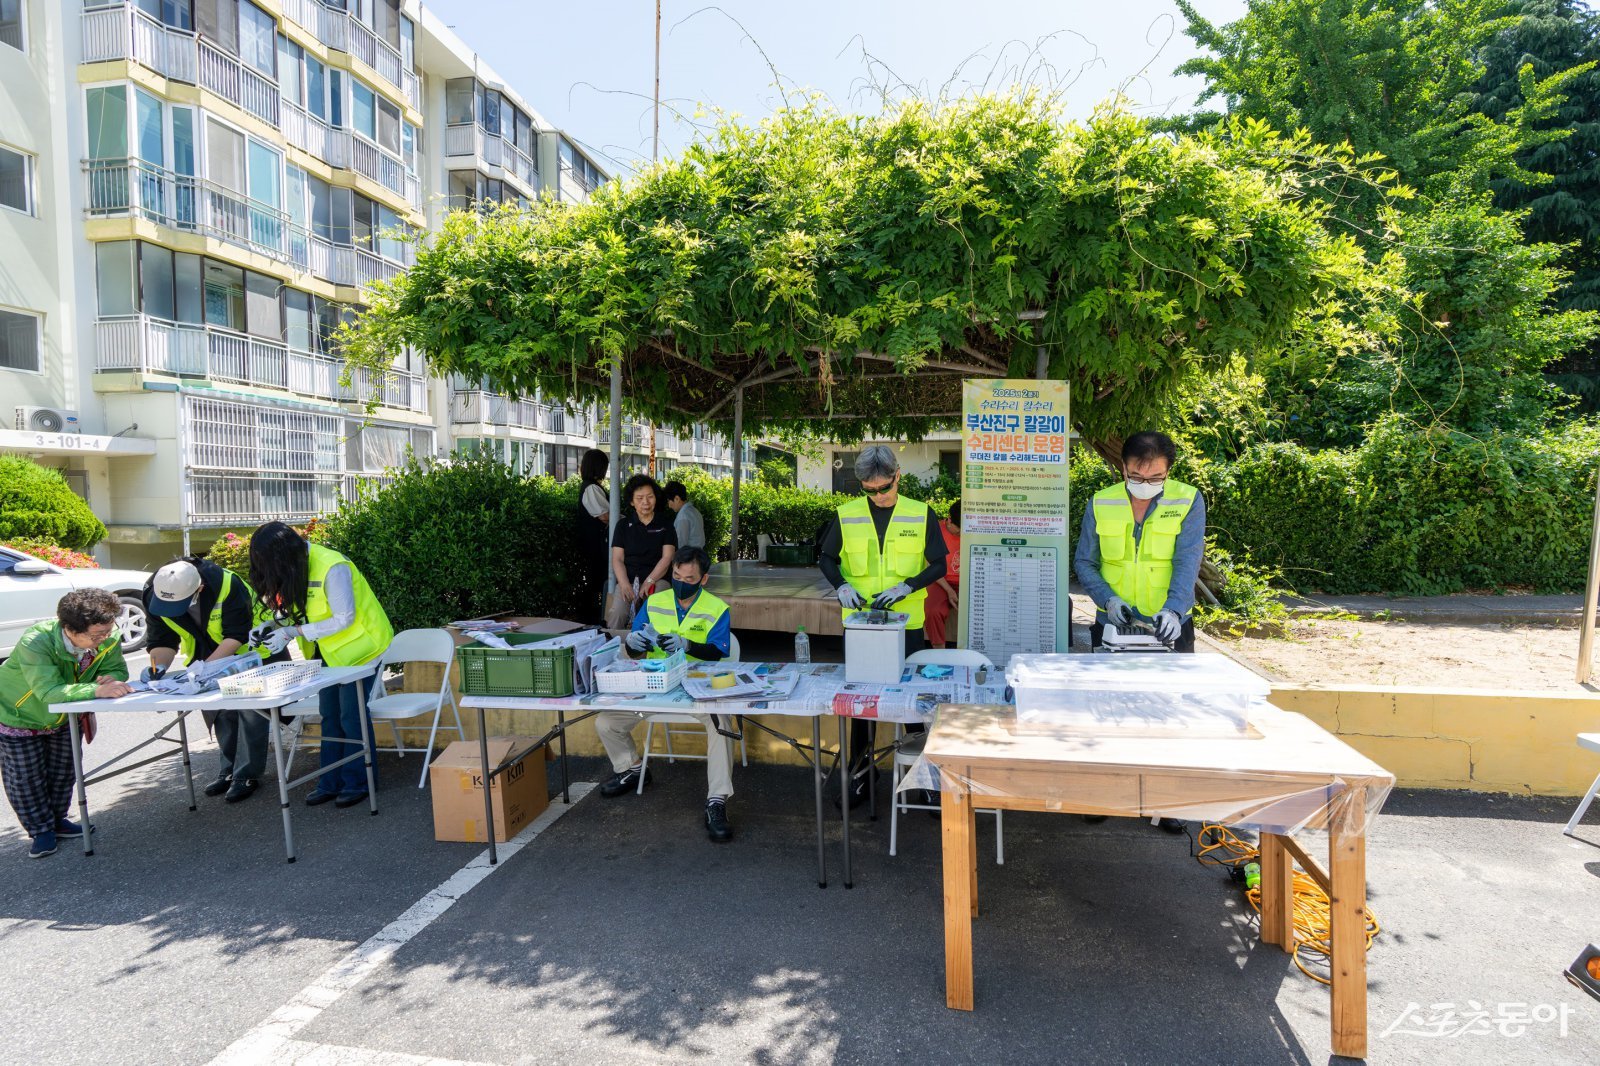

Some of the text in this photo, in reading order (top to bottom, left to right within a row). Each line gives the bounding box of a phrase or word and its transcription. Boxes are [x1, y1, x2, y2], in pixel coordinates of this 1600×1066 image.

[993, 389, 1020, 398] 2025년
[980, 400, 1053, 411] 수리수리 칼수리
[967, 414, 1065, 433] 부산진구 칼갈이
[967, 434, 1065, 453] 수리센터 운영
[993, 453, 1007, 461] 칼을
[1010, 454, 1060, 462] 수리해드립니다
